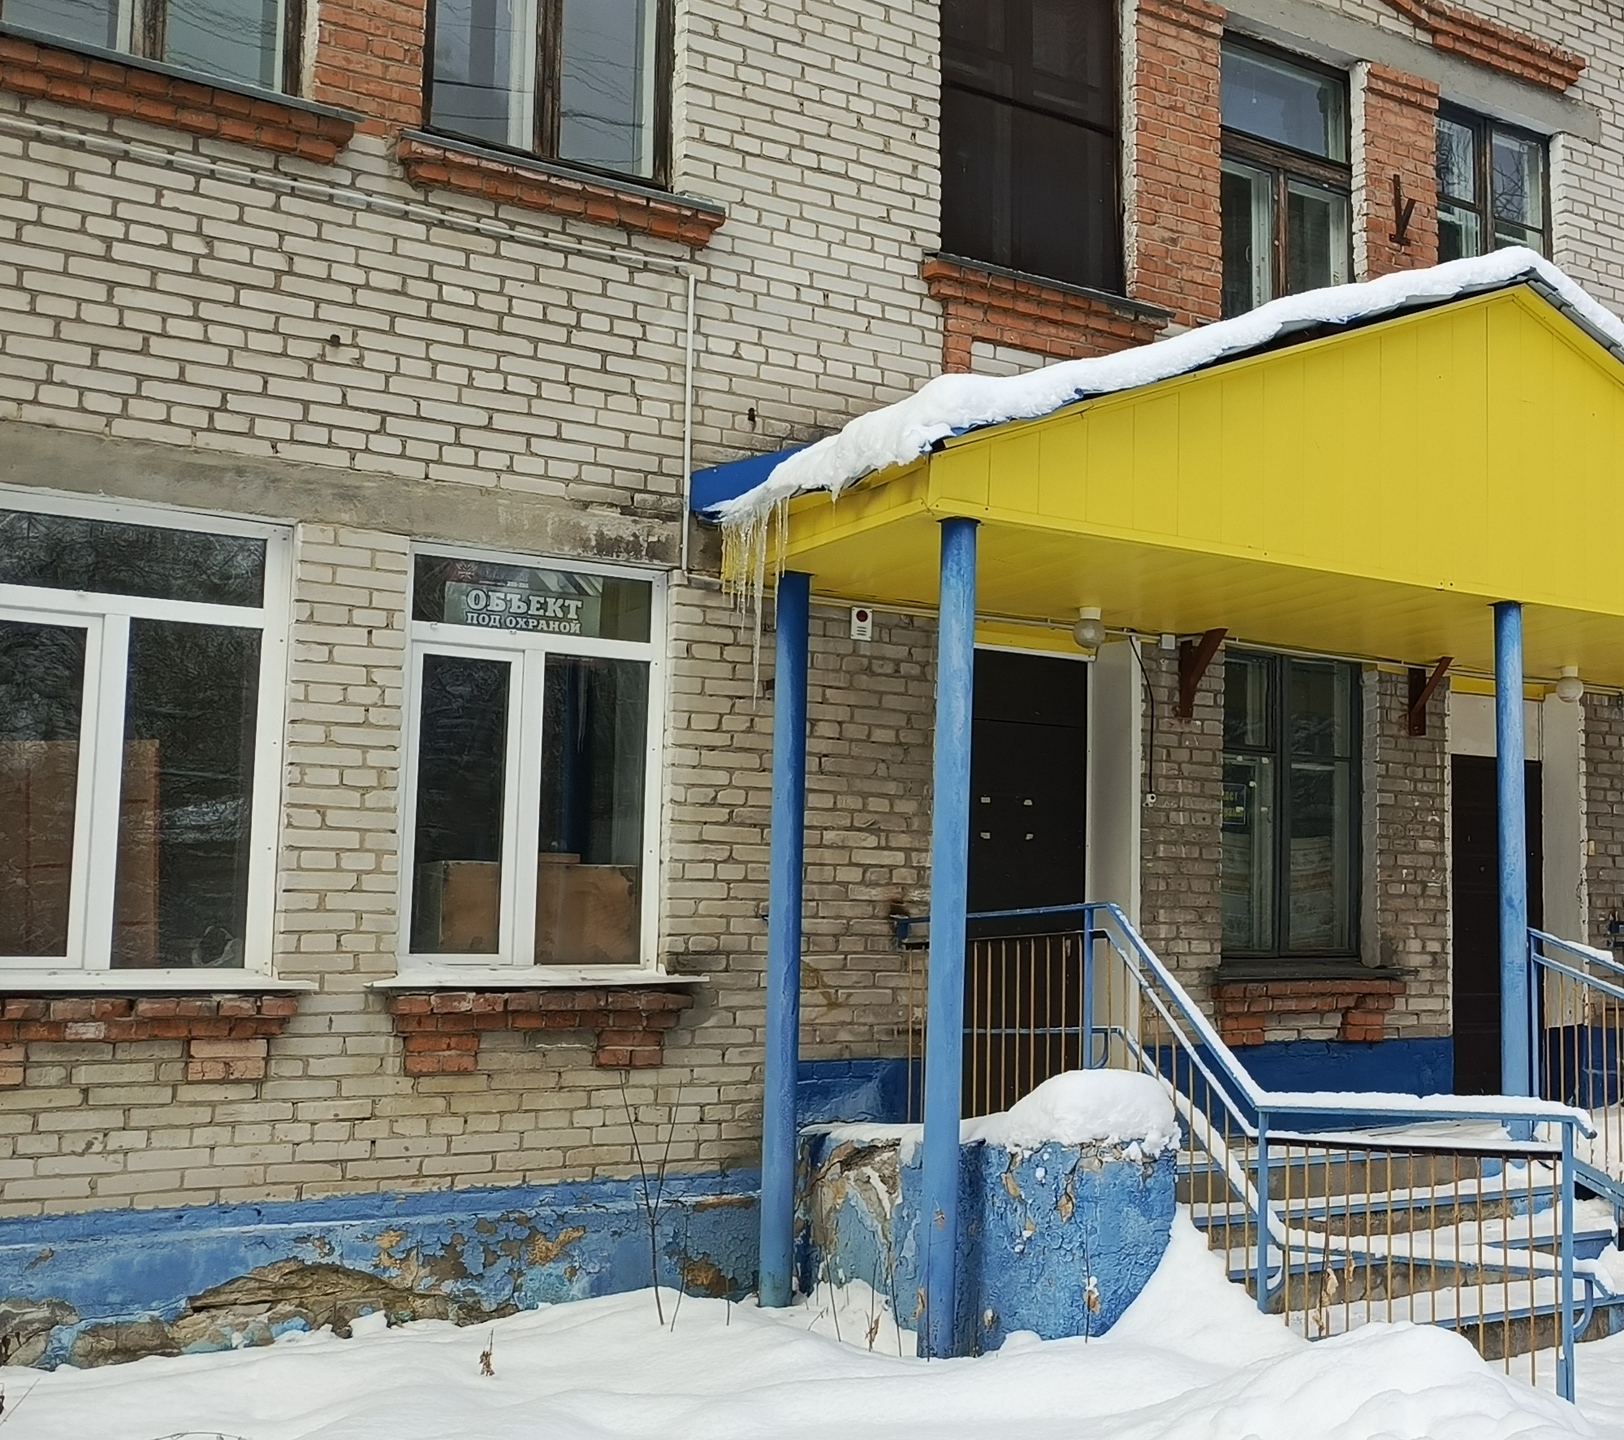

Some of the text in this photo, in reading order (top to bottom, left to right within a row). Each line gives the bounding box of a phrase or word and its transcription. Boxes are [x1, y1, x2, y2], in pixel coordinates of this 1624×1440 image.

[466, 589, 583, 620] ОБЪЕКТ
[466, 612, 582, 635] ПОД ОХРАНОЙ
